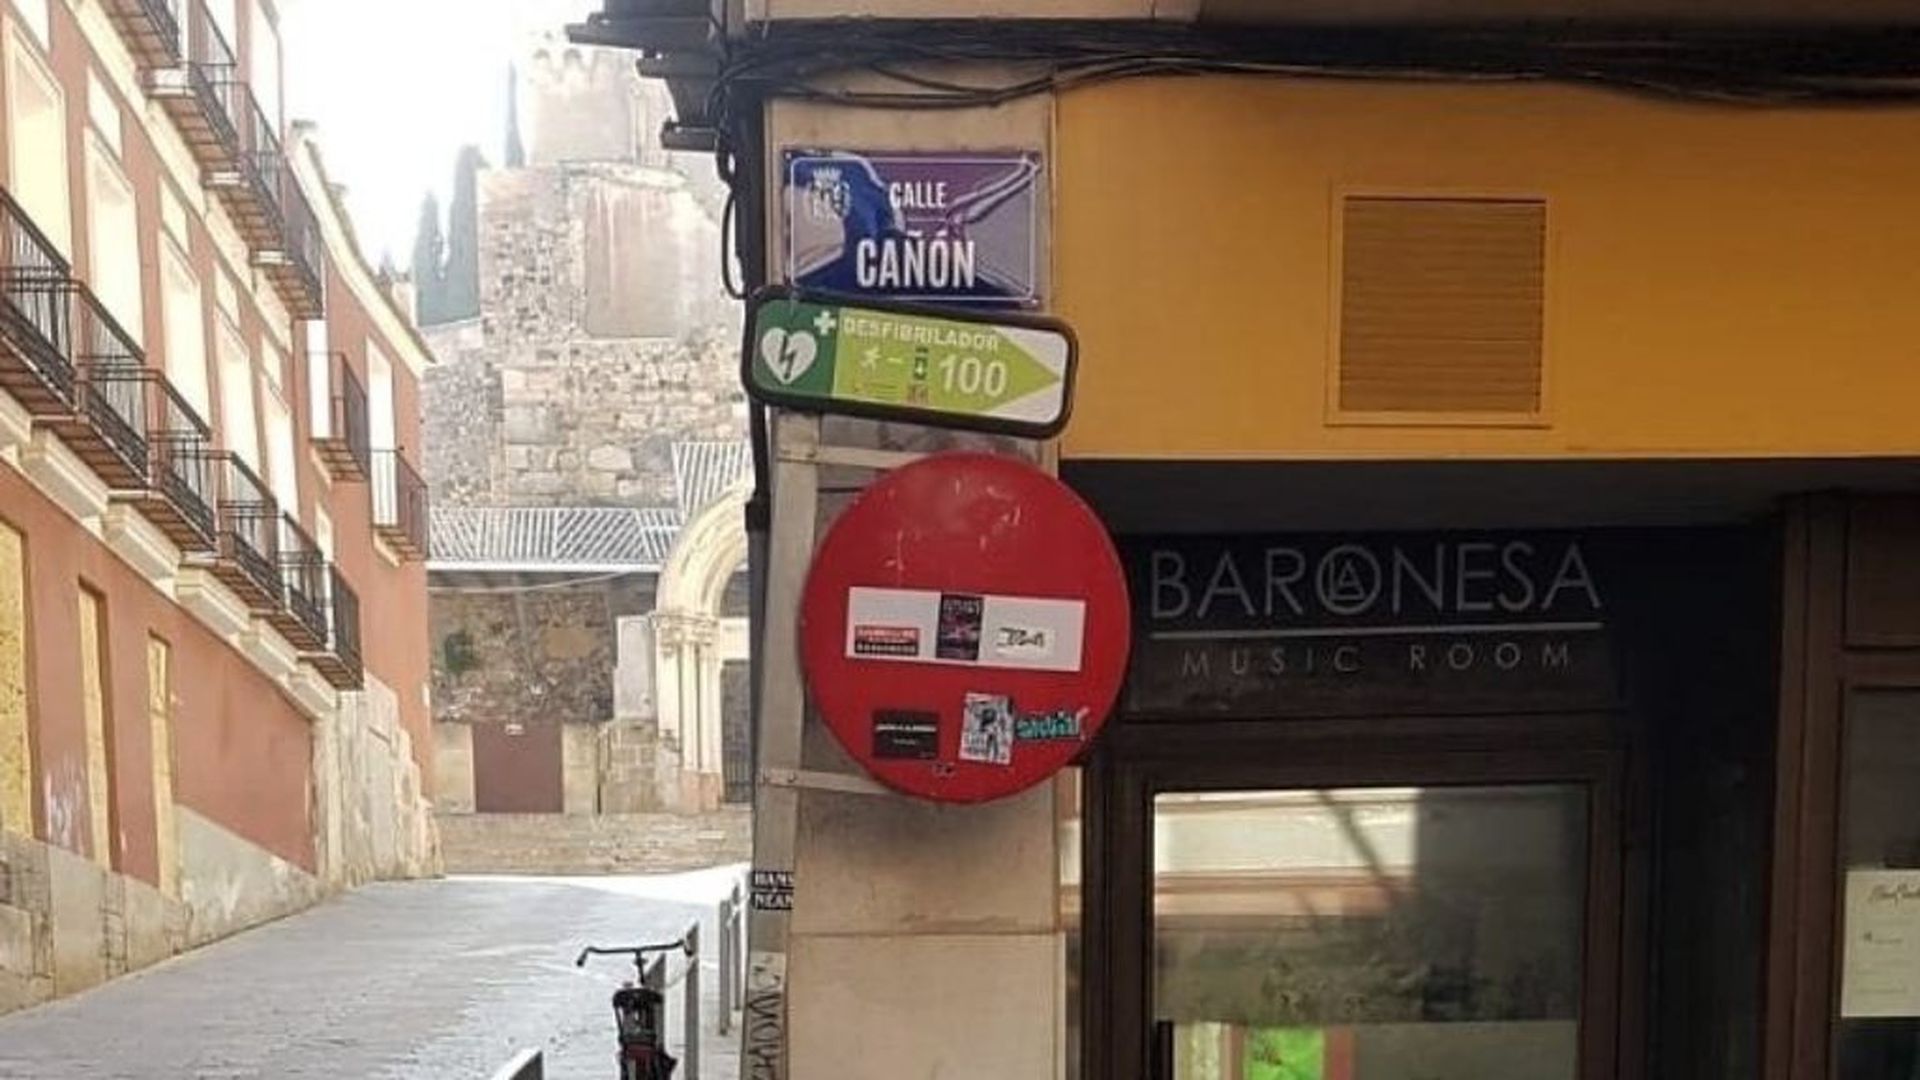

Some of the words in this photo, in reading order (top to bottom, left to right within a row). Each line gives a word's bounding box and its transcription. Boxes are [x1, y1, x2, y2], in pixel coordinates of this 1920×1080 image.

[889, 181, 948, 210] CALLE
[856, 228, 975, 288] CAÑÓN
[843, 317, 999, 352] DESFIBRILADOR
[939, 354, 1007, 397] 100
[1151, 541, 1602, 619] BARONESA
[1181, 646, 1360, 678] MUSIC
[1409, 642, 1570, 672] ROOM
